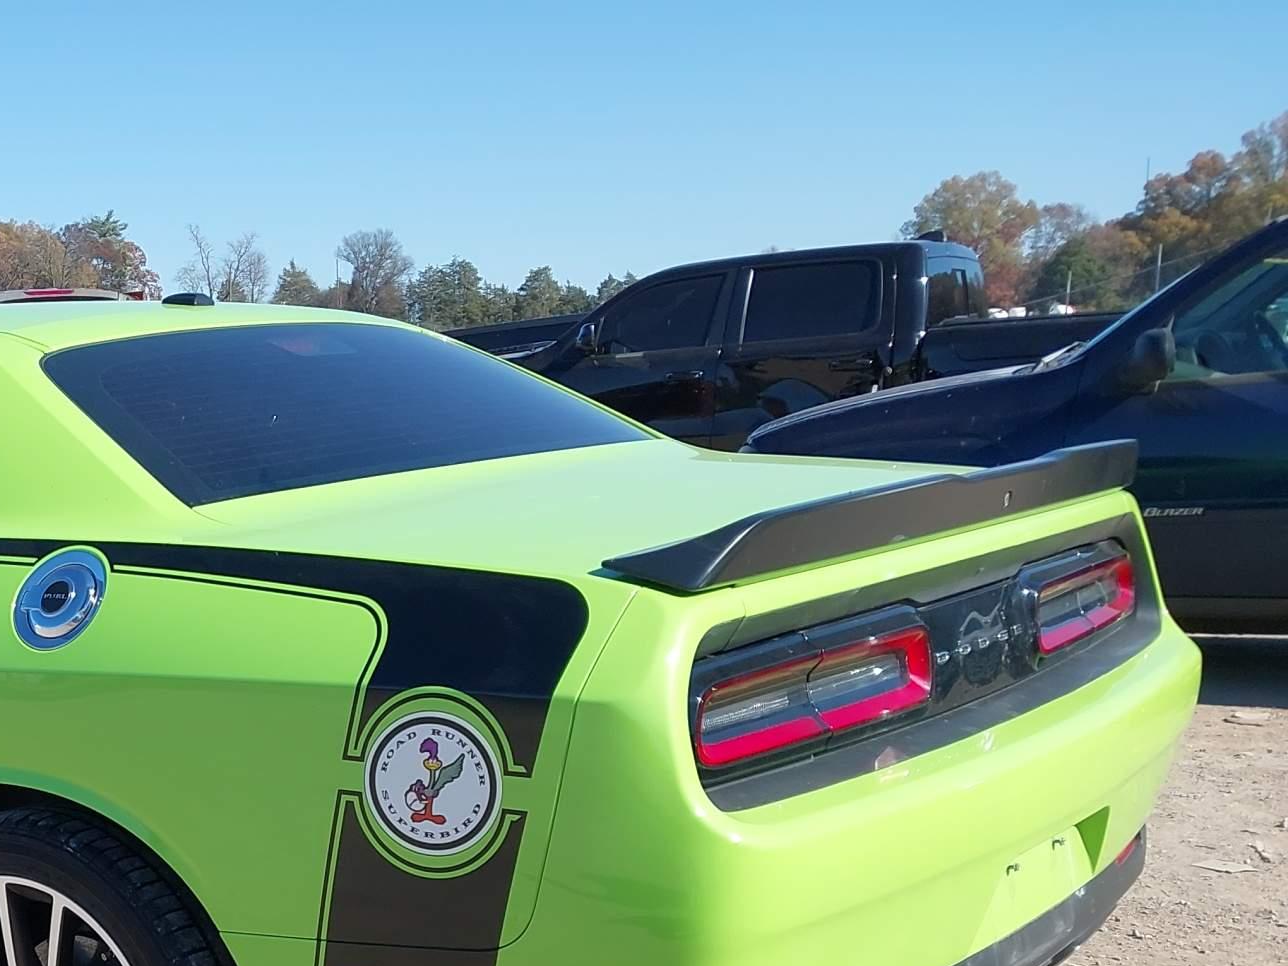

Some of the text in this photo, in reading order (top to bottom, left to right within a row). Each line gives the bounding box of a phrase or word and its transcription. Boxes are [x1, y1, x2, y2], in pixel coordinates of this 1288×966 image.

[1143, 507, 1204, 517] BLAZER
[935, 624, 1023, 666] DODGE
[380, 728, 486, 787] ROAD RUNNER
[381, 789, 481, 839] SUPERBIRD
